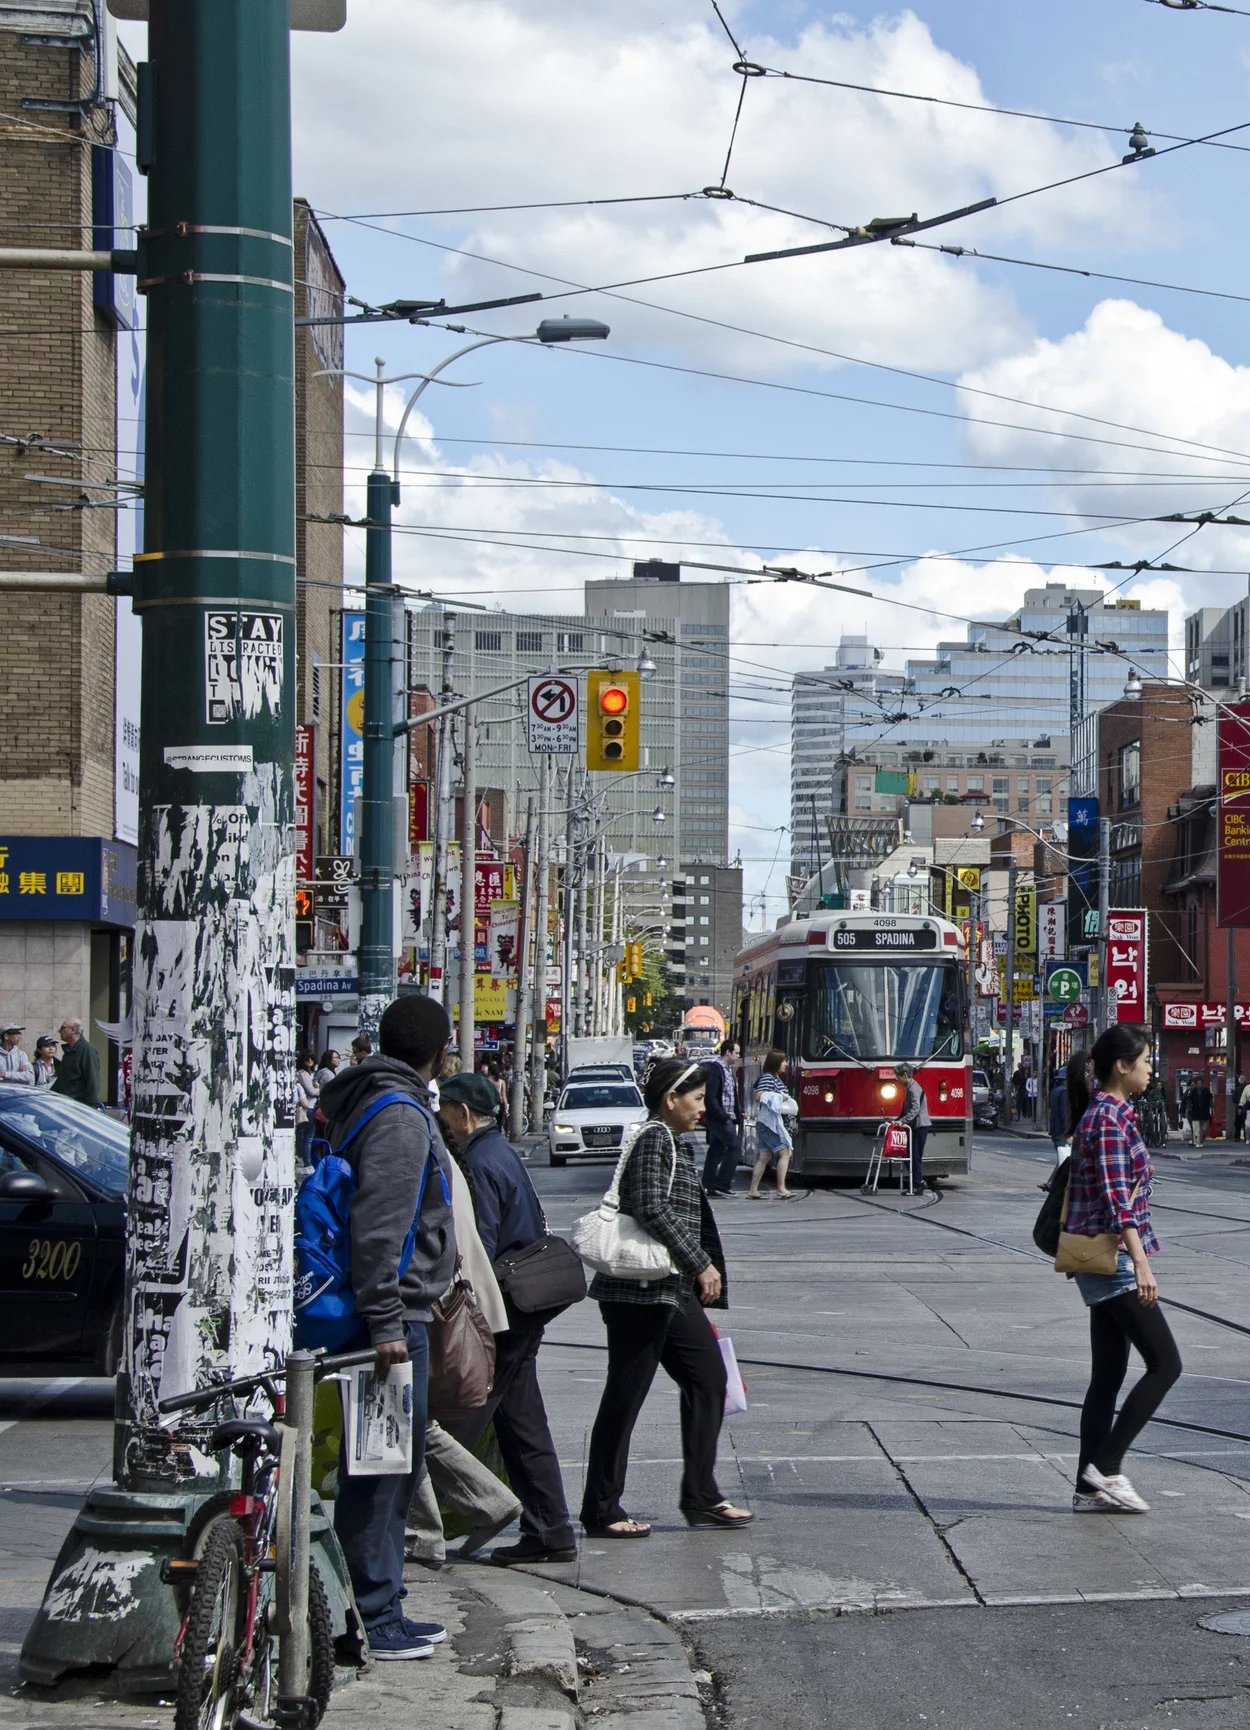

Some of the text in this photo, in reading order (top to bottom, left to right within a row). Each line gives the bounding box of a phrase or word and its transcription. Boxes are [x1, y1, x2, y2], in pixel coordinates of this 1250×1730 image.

[209, 616, 281, 640] STAY
[210, 641, 281, 657] DISRACTED
[1224, 814, 1246, 824] CIBC
[873, 919, 897, 927] 4098
[837, 932, 915, 946] 505 SPADINA
[298, 977, 340, 993] Spadina
[803, 1085, 819, 1096] 4098
[950, 1087, 963, 1098] 4098
[22, 1239, 81, 1281] 3200
